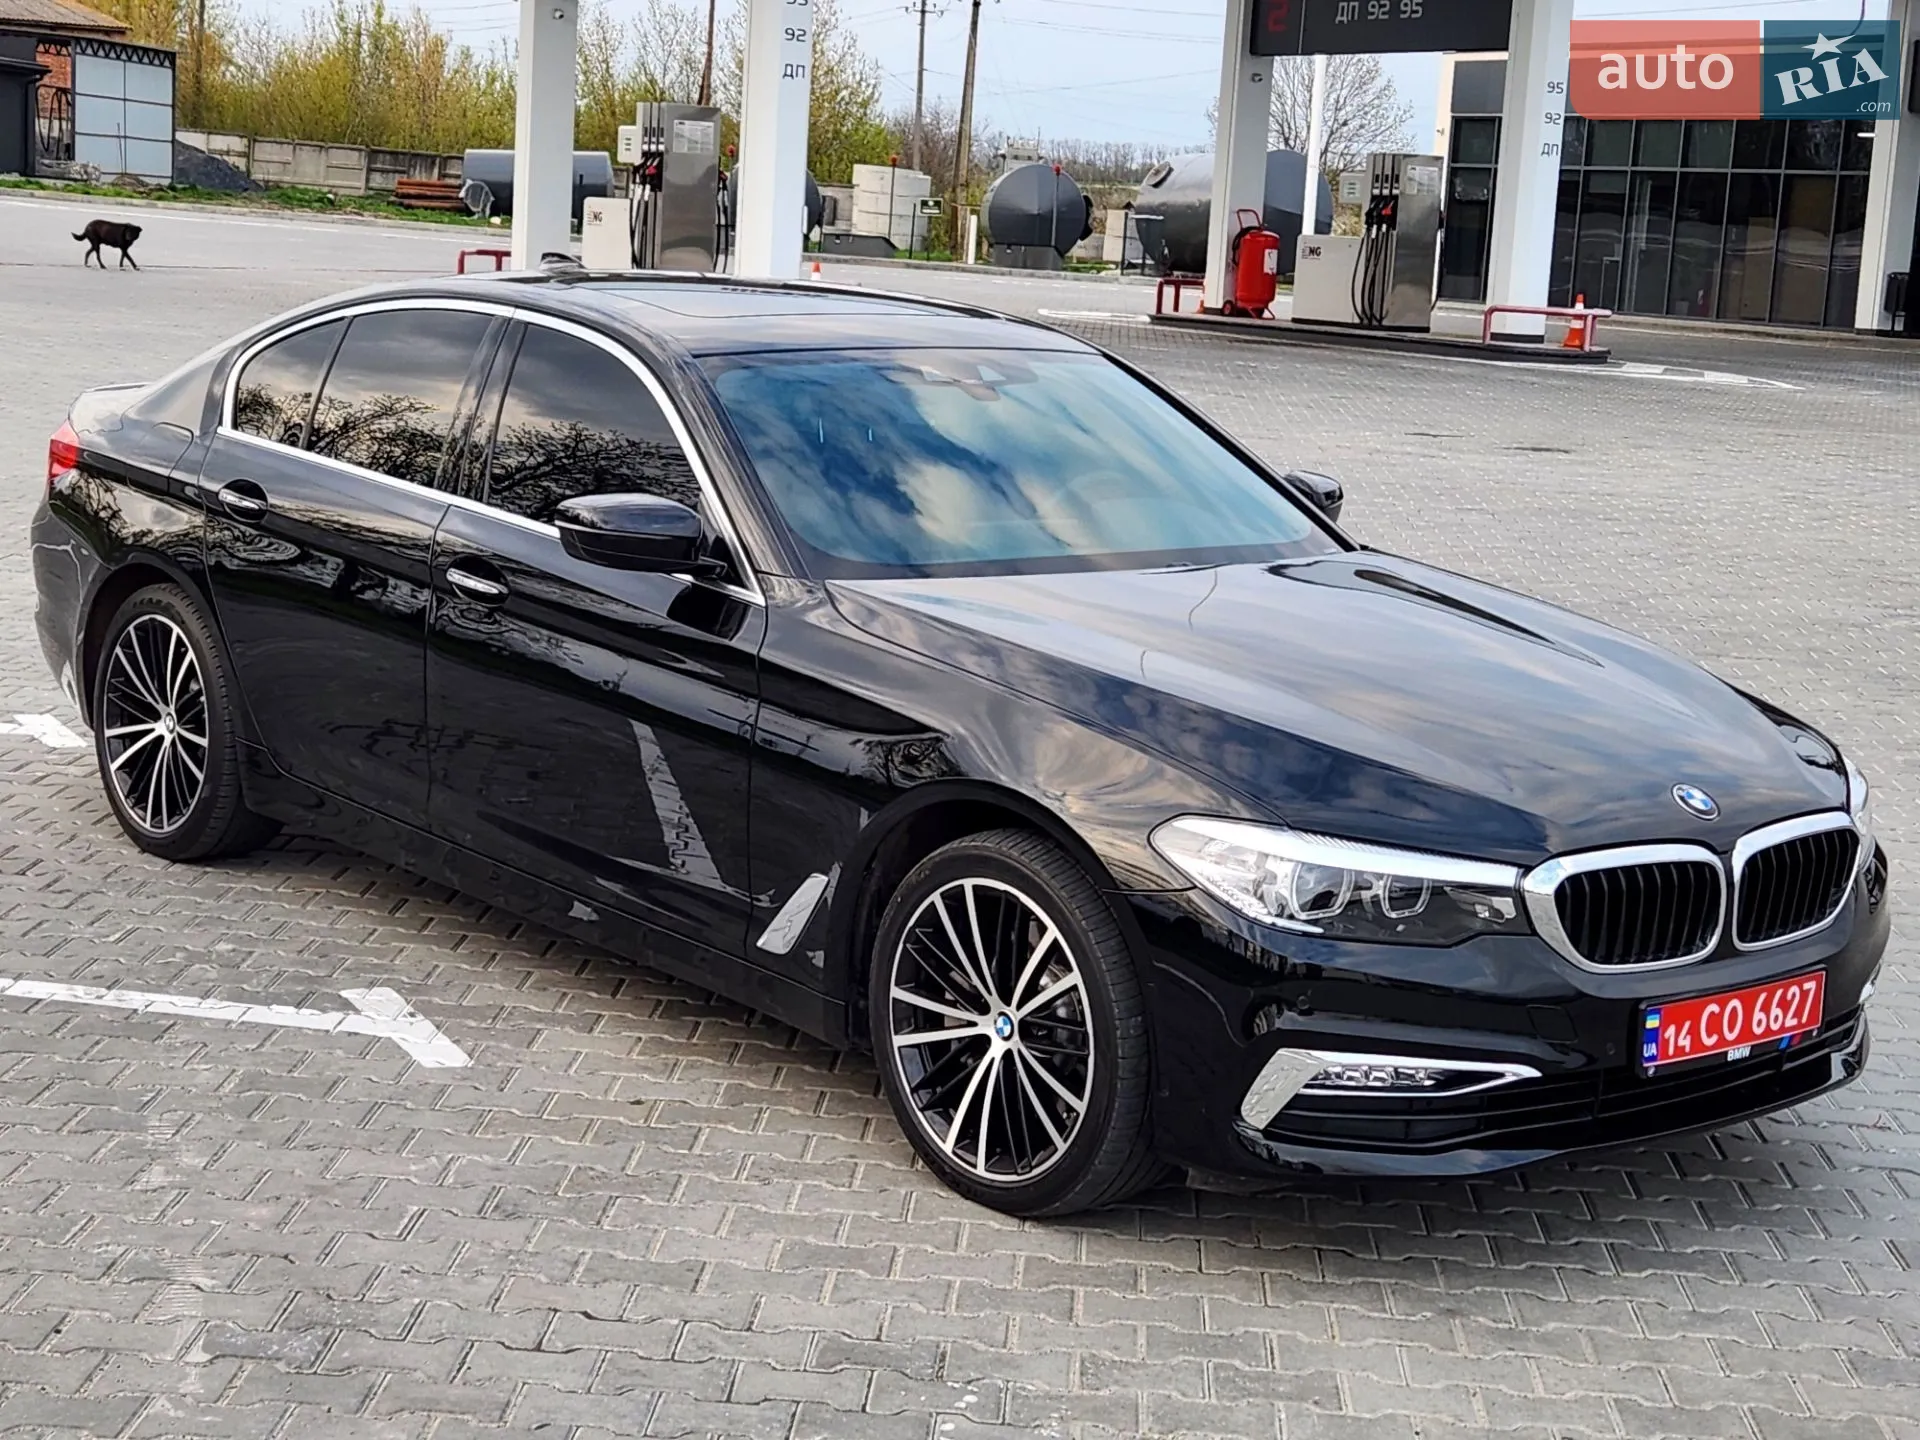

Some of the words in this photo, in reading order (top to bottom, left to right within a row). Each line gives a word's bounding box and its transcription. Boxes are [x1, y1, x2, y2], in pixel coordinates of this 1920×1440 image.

[1335, 2, 1359, 24] ДП
[1367, 1, 1390, 19] 92
[1400, 0, 1423, 18] 95
[784, 27, 807, 42] 92
[782, 63, 806, 80] ДП
[1547, 81, 1564, 94] 95
[1544, 112, 1561, 125] 92
[1541, 143, 1559, 157] ДП
[1664, 1020, 1692, 1056] 14
[1700, 998, 1744, 1047] CO
[1751, 980, 1817, 1036] 6627
[1643, 1043, 1657, 1058] UA
[1727, 1046, 1752, 1062] BMW
